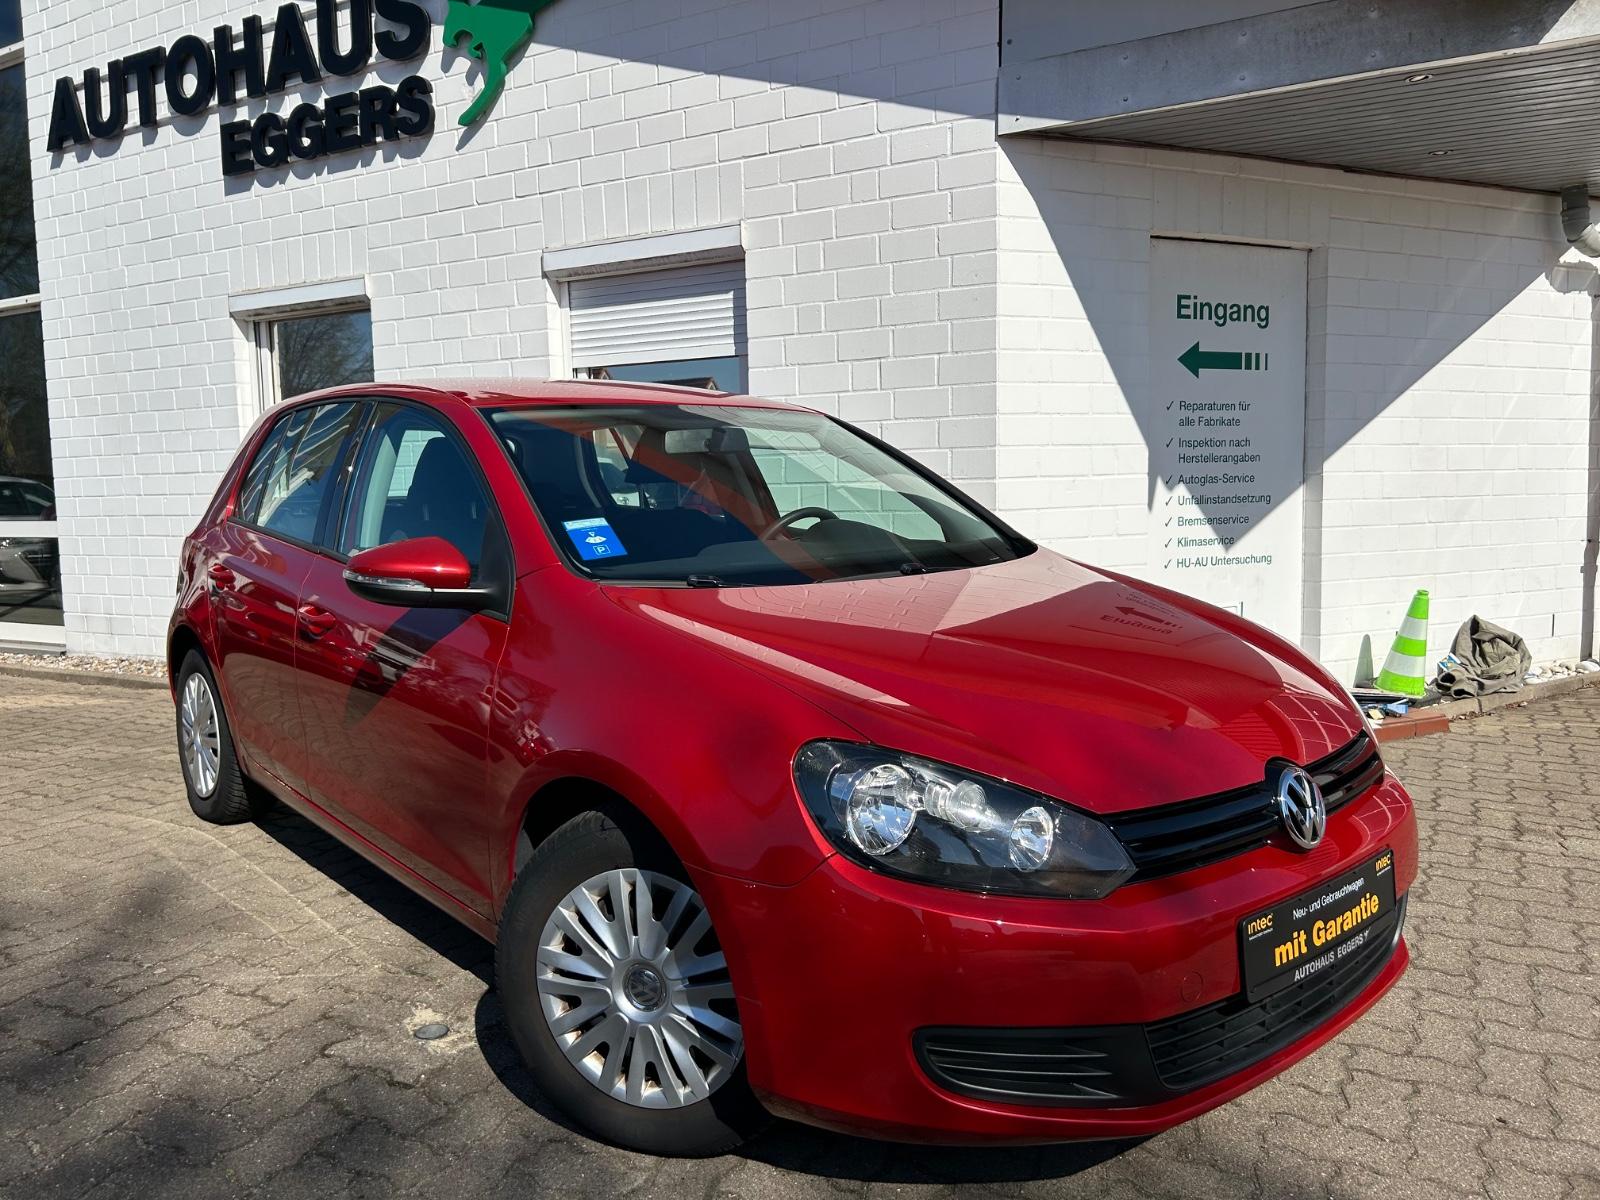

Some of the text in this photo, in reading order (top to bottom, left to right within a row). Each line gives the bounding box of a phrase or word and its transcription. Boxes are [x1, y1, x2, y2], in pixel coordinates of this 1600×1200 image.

[47, 0, 431, 152] AUTOHAUS
[221, 75, 436, 176] EGGERS
[1177, 294, 1270, 329] Eingang
[1179, 401, 1251, 413] Reparaturen für
[1179, 416, 1241, 427] alle Fabrikate
[1178, 437, 1250, 450] Inspektion nach
[1178, 453, 1261, 465] Herstellerangaben
[1178, 473, 1255, 486] Autoglas-Service
[1178, 494, 1271, 506] Unfallinstandsetzung
[1178, 514, 1250, 527] Bremsenservice
[1177, 536, 1235, 548] Klimaservice
[1176, 554, 1272, 569] HU-AU Untersuchung
[1293, 877, 1364, 920] Neu- und Gebrauchtwagen
[1274, 892, 1380, 967] mit Garantie
[1294, 933, 1364, 982] AUTOHAUS EGGERS
